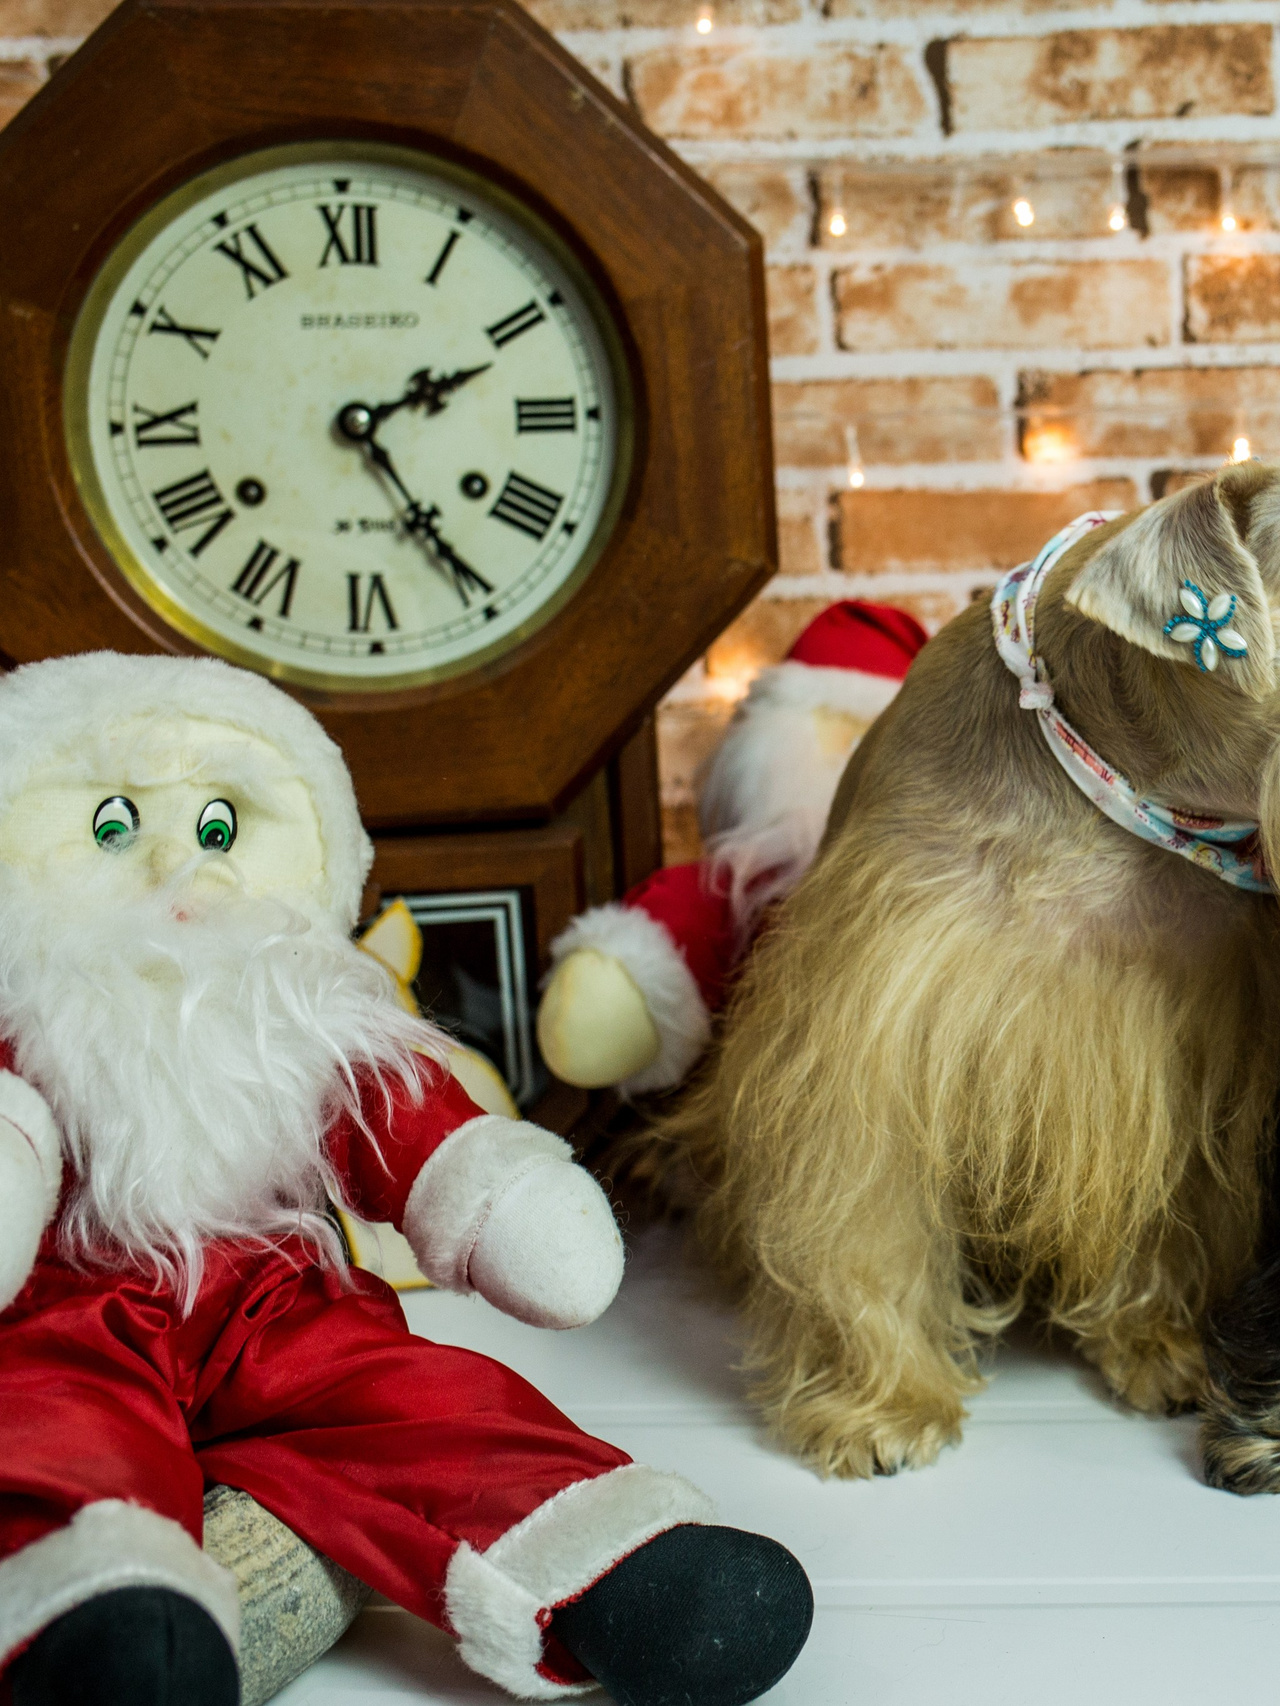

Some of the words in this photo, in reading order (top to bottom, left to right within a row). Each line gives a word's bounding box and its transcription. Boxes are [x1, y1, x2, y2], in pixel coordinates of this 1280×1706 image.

[214, 223, 289, 299] XI
[317, 203, 378, 267] XII
[425, 230, 461, 286] I
[148, 306, 222, 360] X
[485, 300, 547, 350] II
[133, 401, 202, 450] IX
[514, 397, 577, 435] III
[152, 469, 236, 558] VIII
[488, 471, 566, 542] IIII
[231, 540, 301, 619] VII
[347, 573, 399, 634] VI
